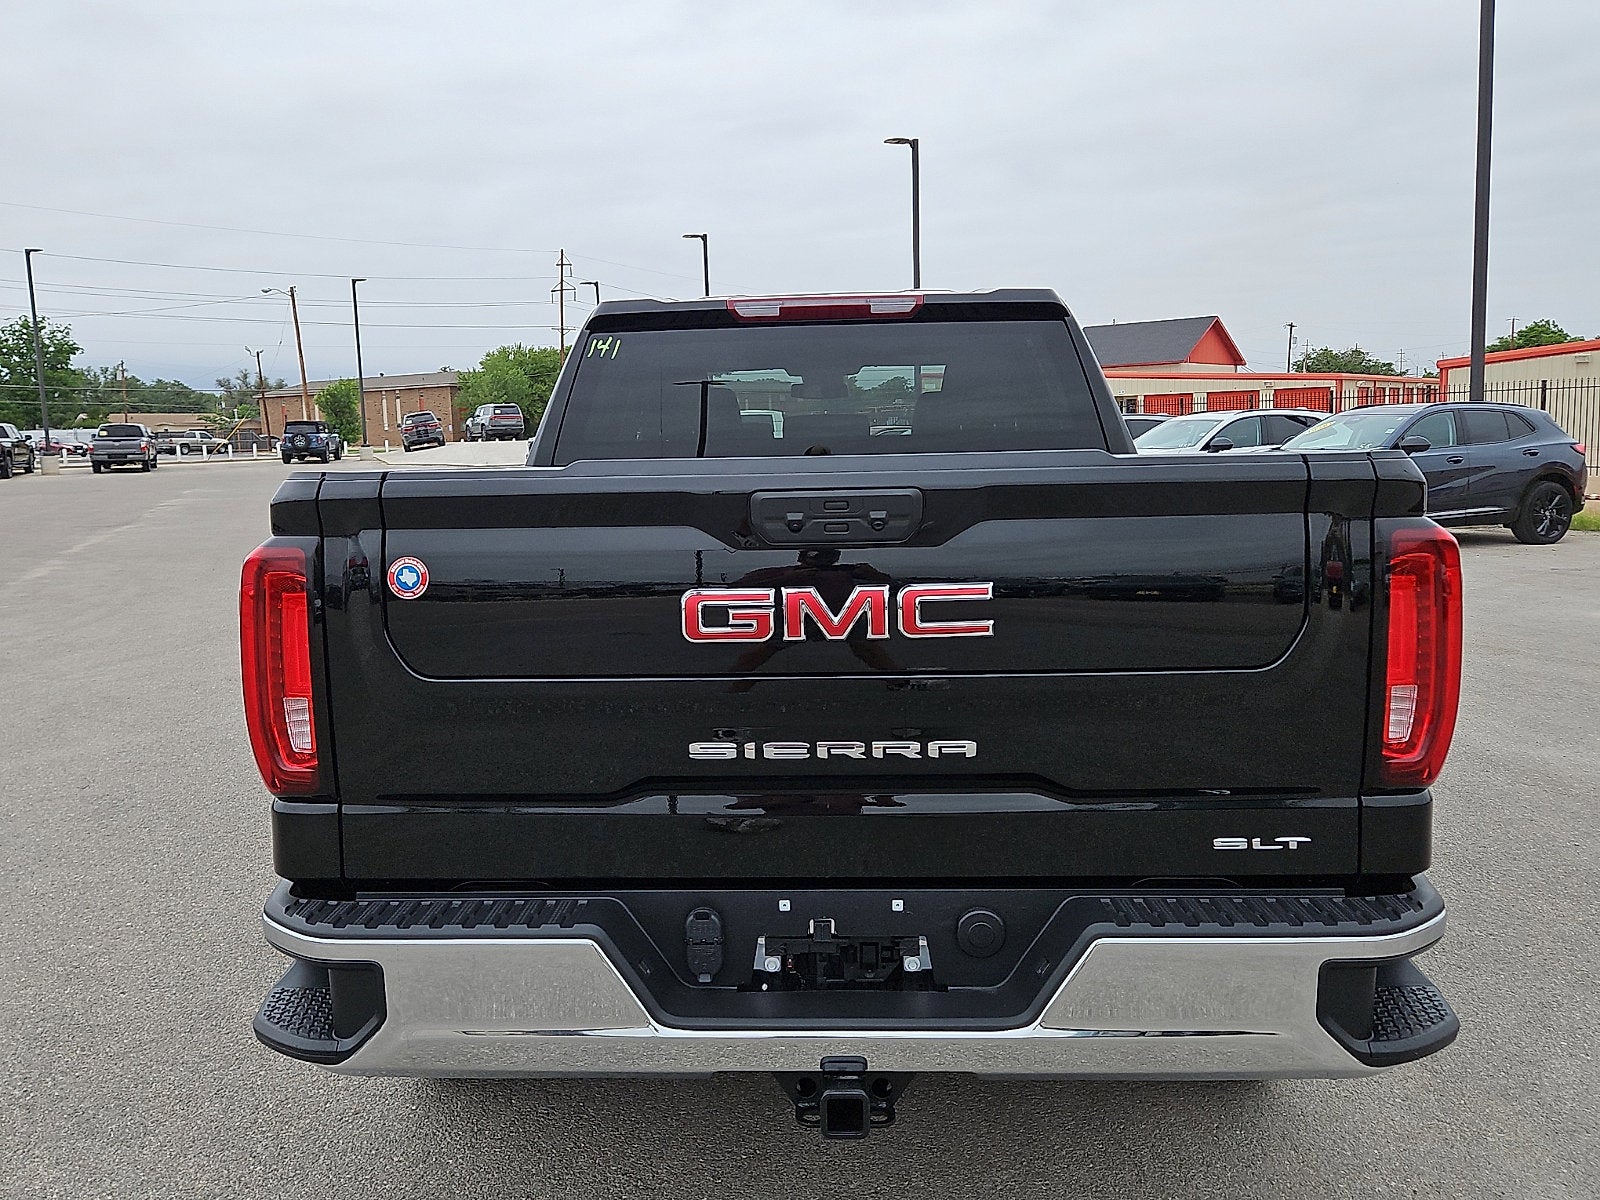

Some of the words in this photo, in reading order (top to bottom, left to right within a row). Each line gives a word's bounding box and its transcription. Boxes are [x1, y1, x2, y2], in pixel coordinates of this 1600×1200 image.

[587, 336, 621, 359] 141
[681, 582, 995, 643] GMC
[688, 740, 978, 760] SIERRA
[1212, 836, 1312, 850] SLT
